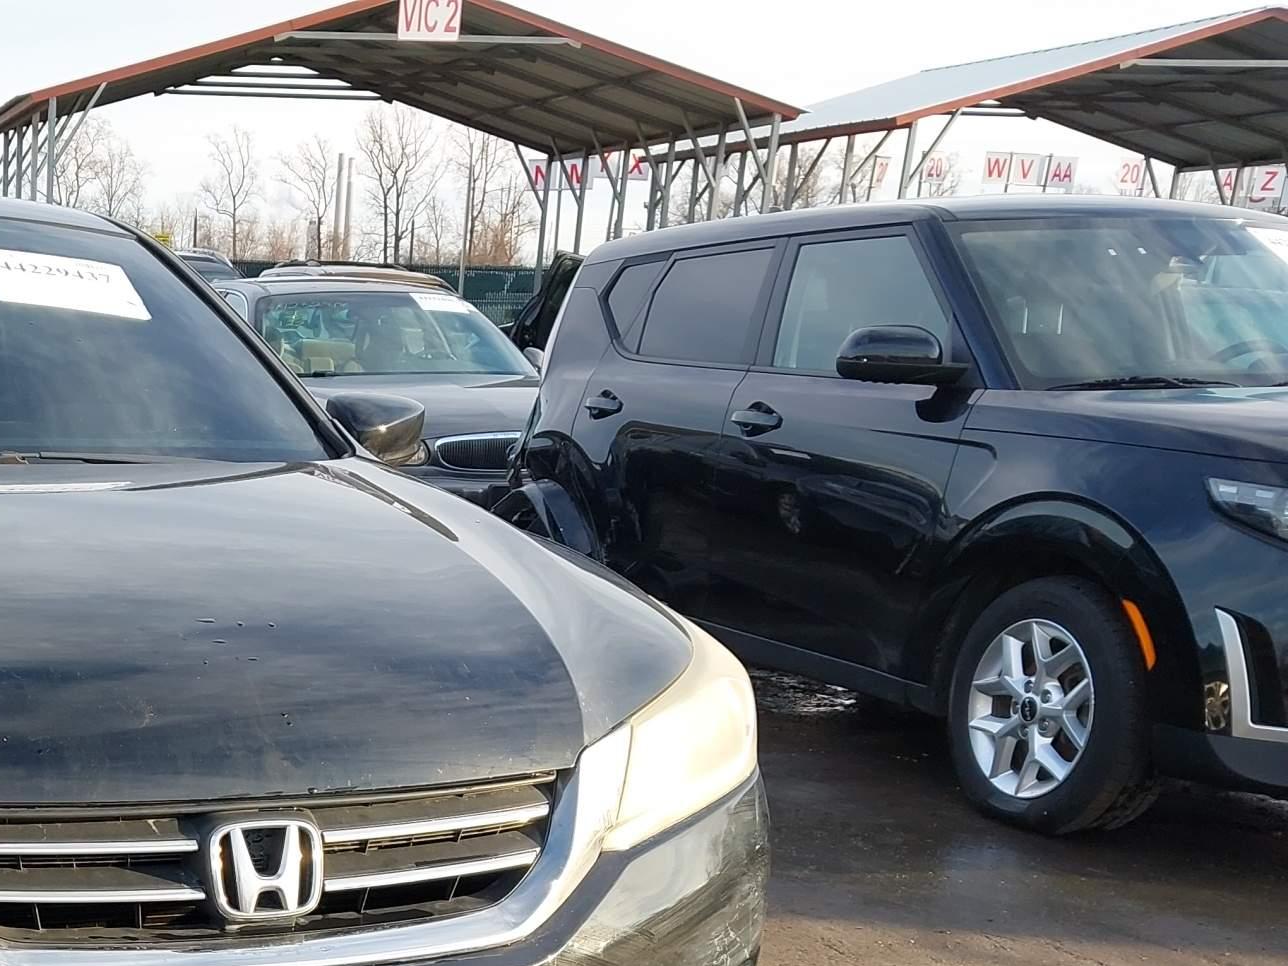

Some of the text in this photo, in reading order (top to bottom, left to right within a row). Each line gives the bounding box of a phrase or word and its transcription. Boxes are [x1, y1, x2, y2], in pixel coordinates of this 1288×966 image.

[403, 0, 459, 32] VIC 2
[927, 158, 943, 178] 20
[987, 157, 1008, 178] W
[1021, 159, 1034, 179] V
[1050, 162, 1072, 183] AA
[1120, 162, 1141, 184] 20
[1260, 171, 1279, 191] Z
[0, 261, 110, 284] 44229437
